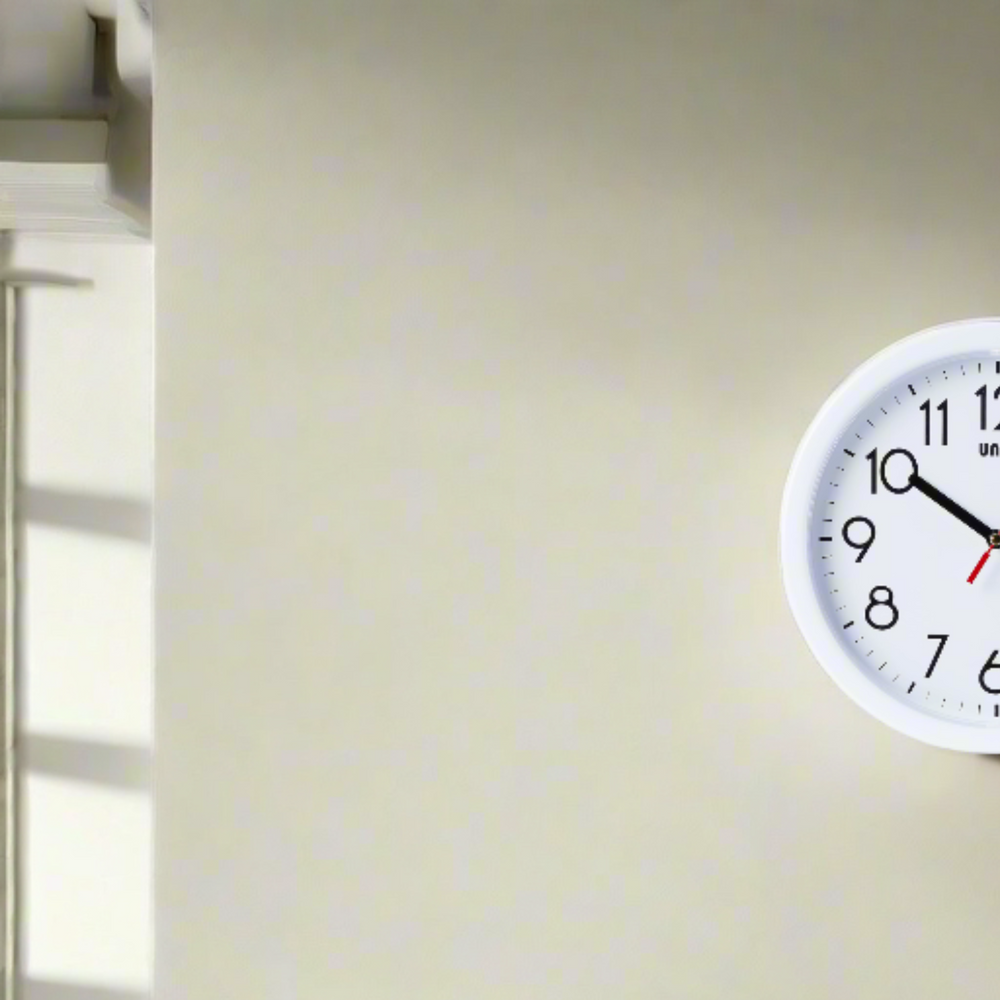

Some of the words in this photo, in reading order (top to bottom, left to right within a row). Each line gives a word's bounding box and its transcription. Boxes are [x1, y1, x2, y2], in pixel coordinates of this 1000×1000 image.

[919, 399, 948, 446] 11
[866, 448, 919, 494] 10
[842, 516, 876, 563] 9
[865, 586, 899, 631] 8
[925, 635, 950, 679] 7
